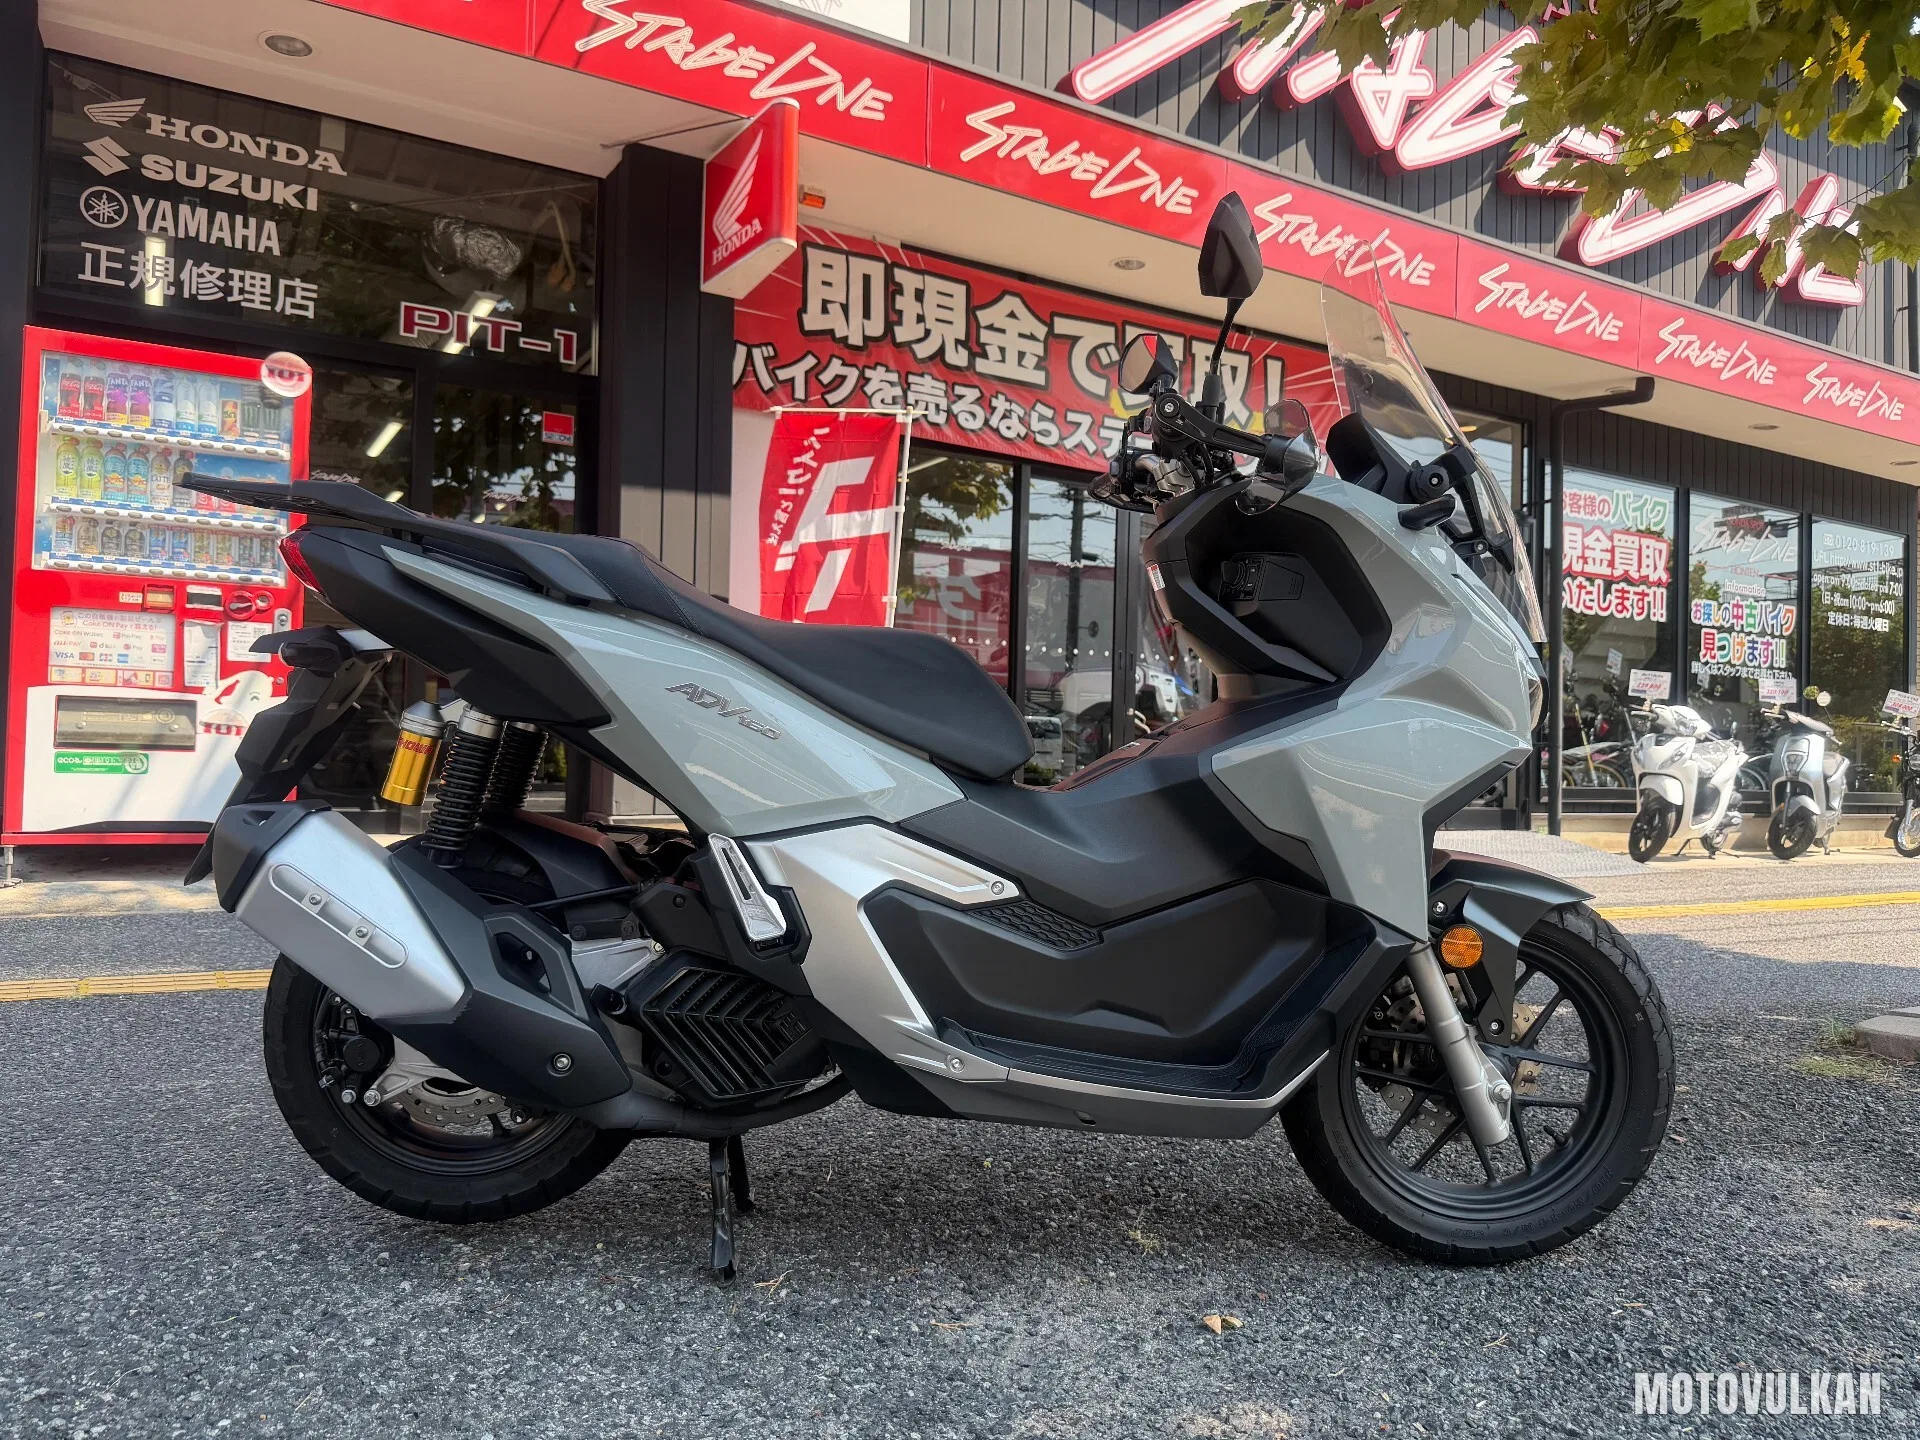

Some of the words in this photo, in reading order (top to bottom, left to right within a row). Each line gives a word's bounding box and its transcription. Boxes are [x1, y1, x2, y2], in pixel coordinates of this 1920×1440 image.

[146, 113, 347, 176] HONDA
[141, 154, 318, 211] SUZUKI
[132, 195, 281, 256] YAMAHA
[712, 217, 763, 266] HONDA
[78, 241, 318, 320] 正規修理店
[401, 302, 577, 364] PIT-1
[1724, 579, 1766, 597] Information
[1691, 597, 1796, 636] お探しの中古バイク
[54, 651, 75, 659] VISA
[1700, 628, 1787, 668] 見つけます!!
[664, 681, 752, 718] ADV
